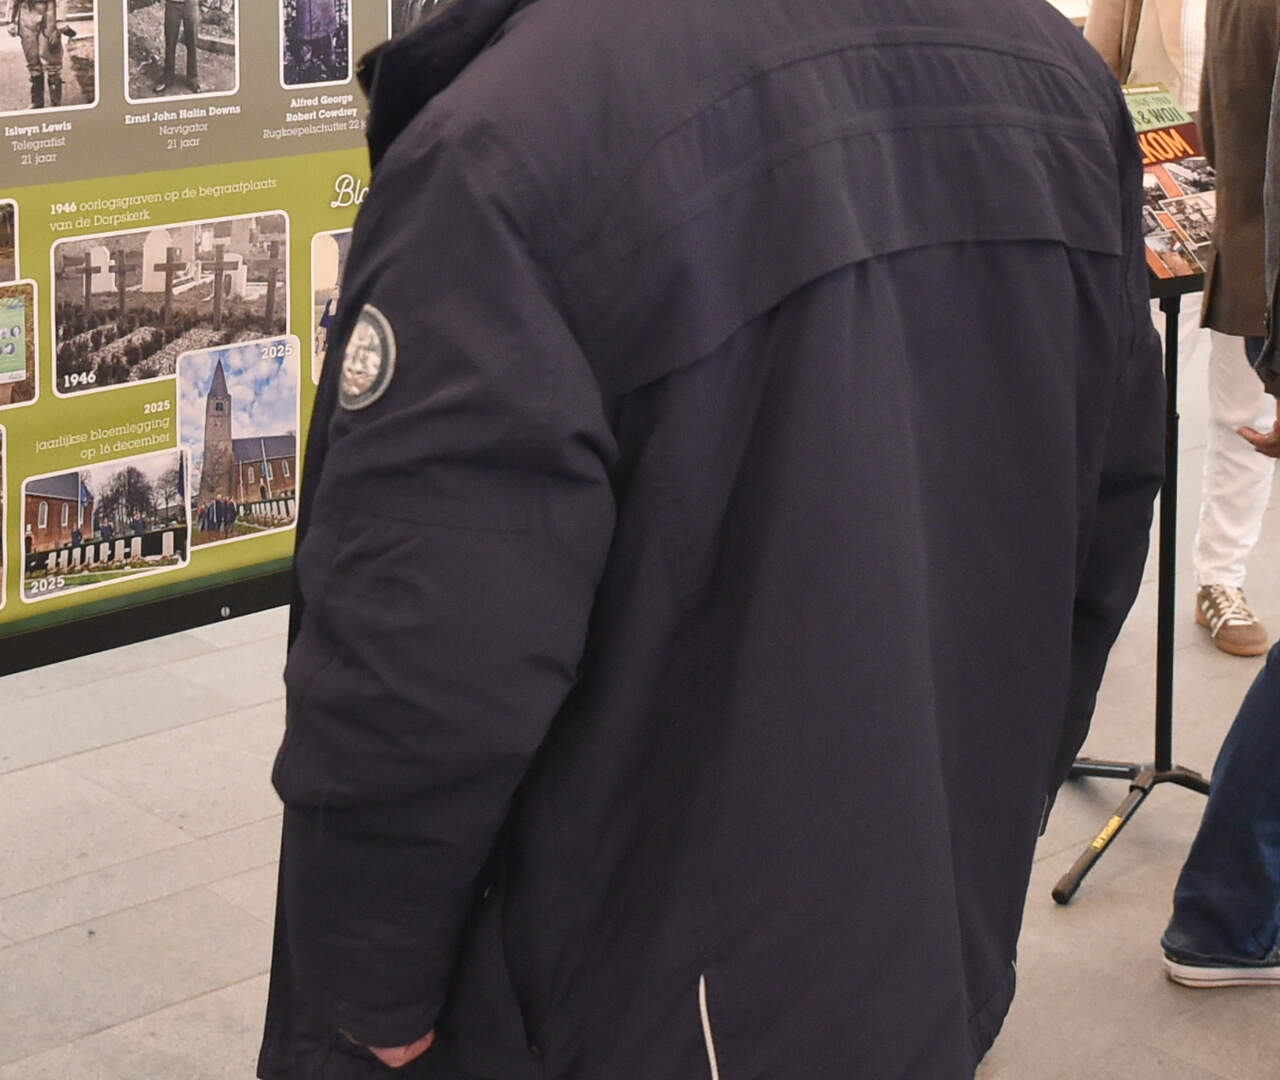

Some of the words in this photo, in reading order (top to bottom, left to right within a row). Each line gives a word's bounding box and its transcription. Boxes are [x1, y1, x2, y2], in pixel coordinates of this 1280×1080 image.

[290, 96, 318, 108] Alfred
[320, 94, 353, 104] George
[124, 113, 150, 124] Ernst
[152, 111, 177, 121] John
[208, 105, 241, 116] Downs
[285, 110, 316, 122] Robert
[318, 107, 357, 118] Cowdrey
[4, 125, 40, 136] Islwyn
[41, 120, 72, 132] Lewis
[159, 123, 208, 135] Navigator
[11, 136, 66, 151] Telegrafist
[167, 138, 177, 149] 21
[179, 138, 200, 149] jaar
[21, 154, 32, 165] 21
[35, 153, 56, 165] jaar
[50, 201, 77, 215] 1946
[79, 193, 162, 211] oorlogsgraven
[163, 191, 179, 202] op
[181, 187, 197, 198] de
[198, 178, 276, 197] begraafplaats
[49, 220, 73, 231] van
[75, 216, 91, 228] de
[93, 209, 150, 226] Dorpskerk
[261, 342, 293, 361] 2025
[63, 370, 96, 389] 1946
[143, 400, 171, 415] 2025
[35, 433, 88, 453] jaarlijkse
[90, 417, 169, 440] bloemlegging
[79, 447, 96, 460] op
[99, 443, 111, 454] 16
[112, 432, 170, 452] december
[31, 576, 66, 594] 2025
